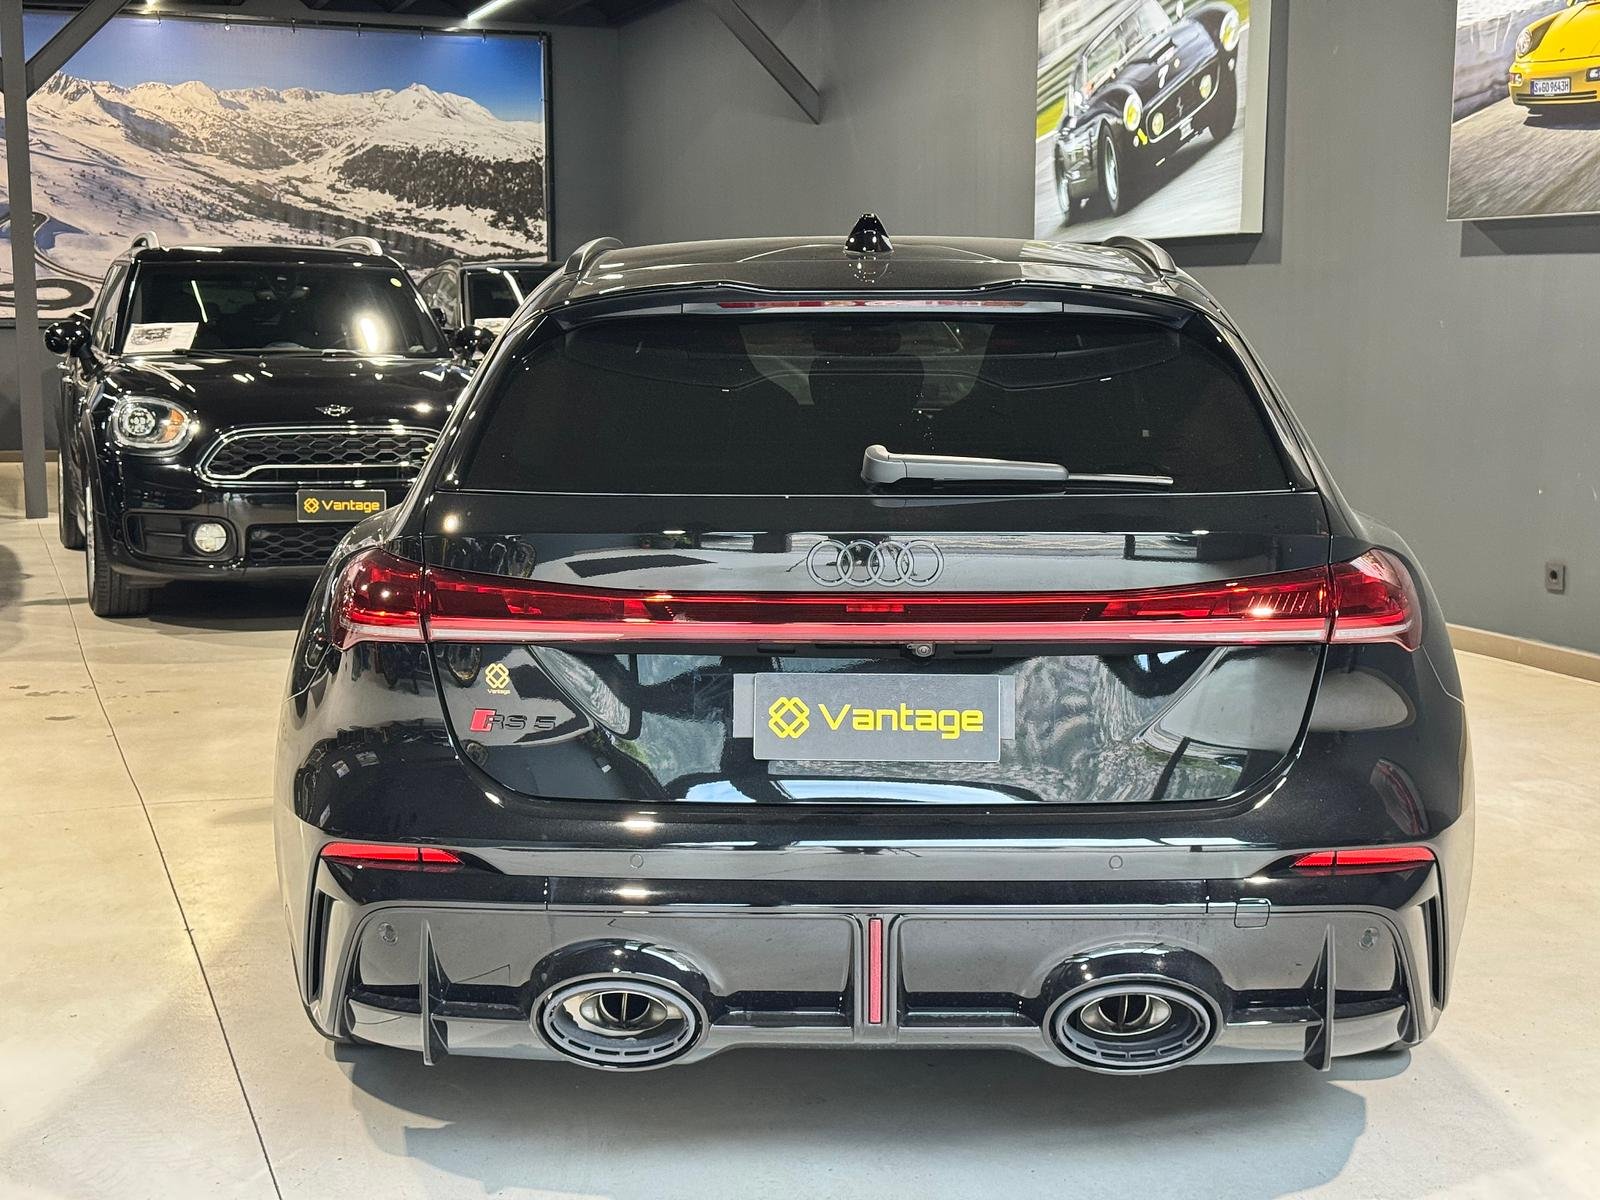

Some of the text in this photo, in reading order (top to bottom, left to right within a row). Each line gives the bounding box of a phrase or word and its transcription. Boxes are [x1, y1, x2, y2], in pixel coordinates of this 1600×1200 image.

[321, 499, 380, 513] Vantage
[483, 714, 556, 730] RS 5
[818, 703, 984, 740] Vantage
